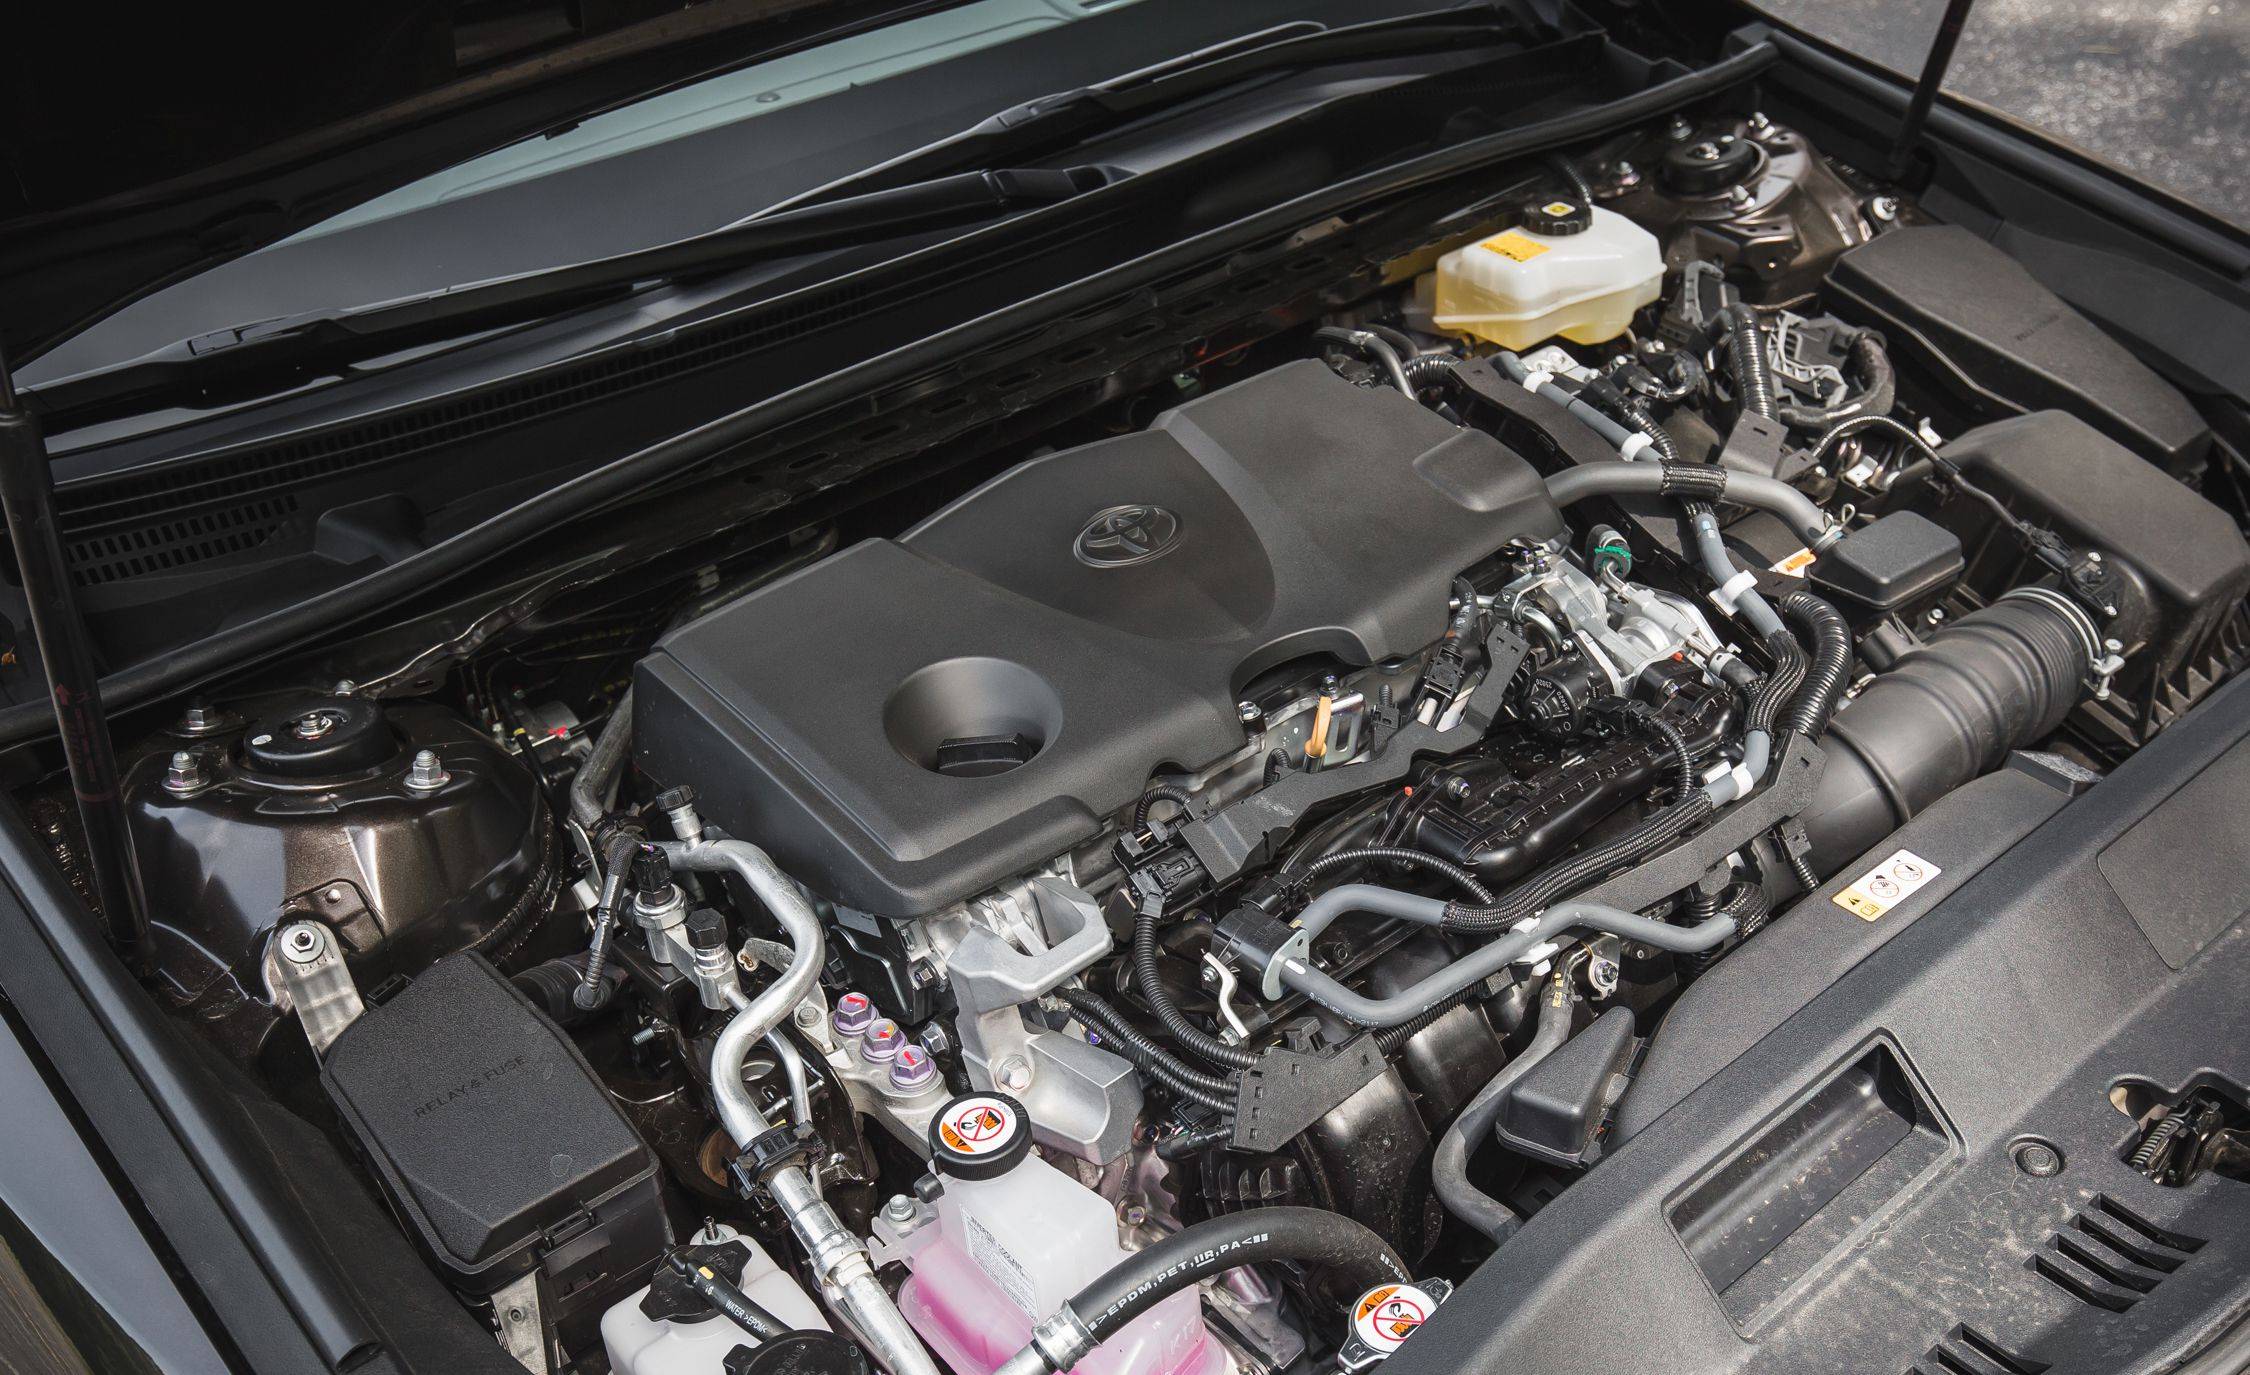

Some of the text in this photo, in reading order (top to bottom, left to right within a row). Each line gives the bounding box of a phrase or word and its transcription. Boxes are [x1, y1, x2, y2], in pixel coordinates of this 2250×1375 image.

[1556, 691, 1570, 711] 25620
[414, 1083, 467, 1119] RELAY
[483, 1054, 526, 1082] FUSE
[725, 1299, 744, 1319] WATER
